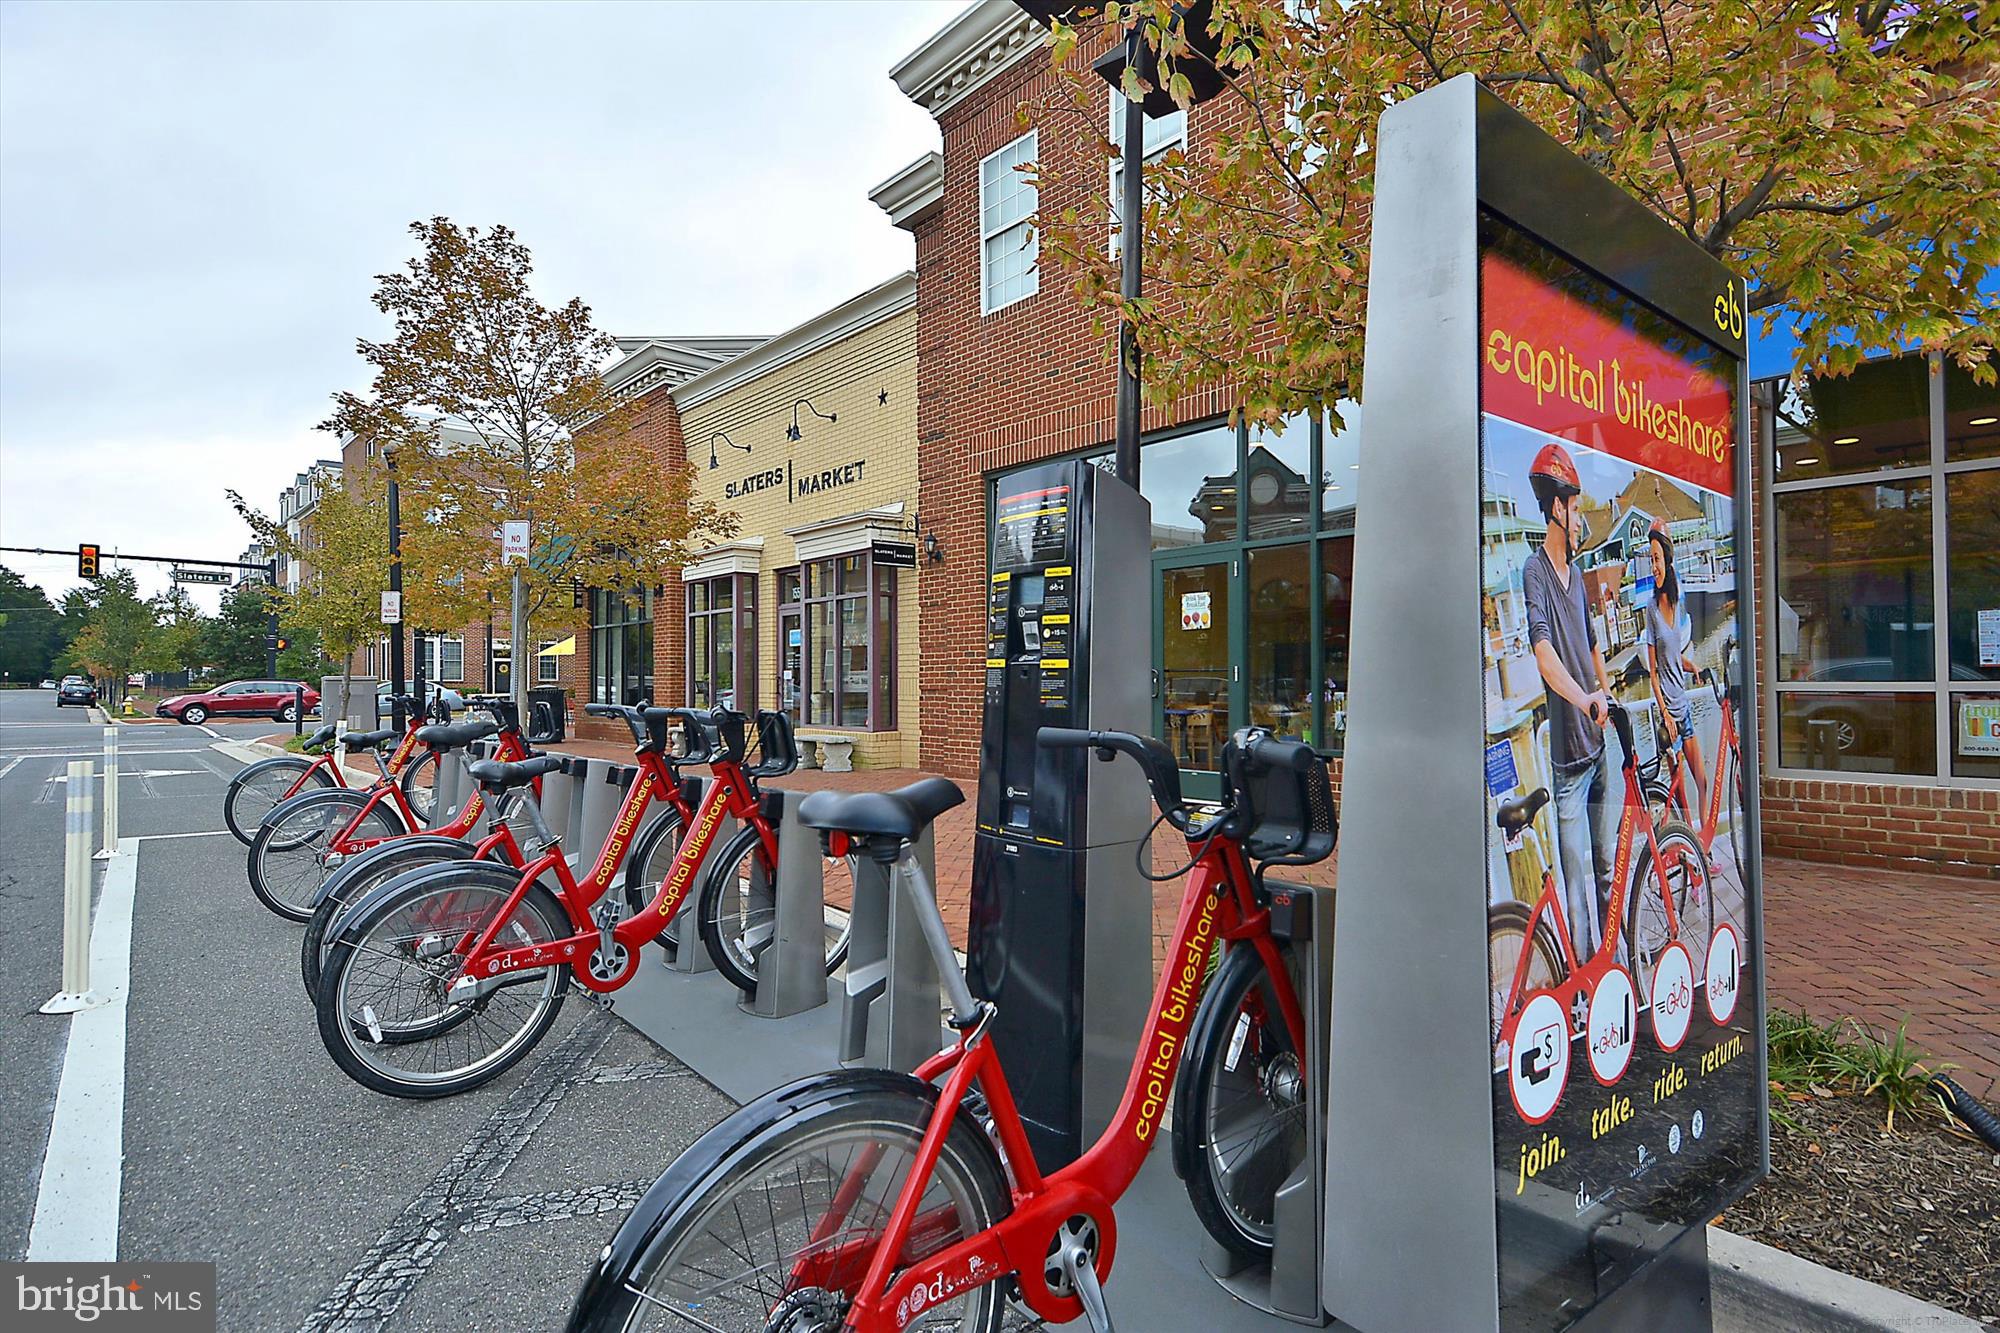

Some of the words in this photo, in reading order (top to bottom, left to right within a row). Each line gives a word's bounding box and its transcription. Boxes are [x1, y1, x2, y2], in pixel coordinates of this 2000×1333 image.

[1487, 329, 1604, 414] capital
[1611, 358, 1725, 464] bikeshare
[725, 467, 783, 499] SLATERS
[798, 459, 865, 497] MARKET
[177, 572, 213, 581] Slaters
[505, 546, 526, 554] PARKING
[511, 535, 521, 543] NO
[463, 795, 482, 826] capita
[596, 837, 623, 885] capital
[617, 779, 652, 836] bikeshare
[658, 861, 691, 916] capital
[681, 793, 727, 859] bikeshare
[1605, 889, 1620, 952] capital
[1613, 804, 1632, 884] bikeshare
[1136, 1031, 1176, 1141] capital
[1161, 894, 1218, 1024] bikeshare
[1516, 1132, 1567, 1195] join.
[1591, 1094, 1635, 1140] take.
[1653, 1062, 1688, 1104] ride.
[1700, 1035, 1744, 1077] return.
